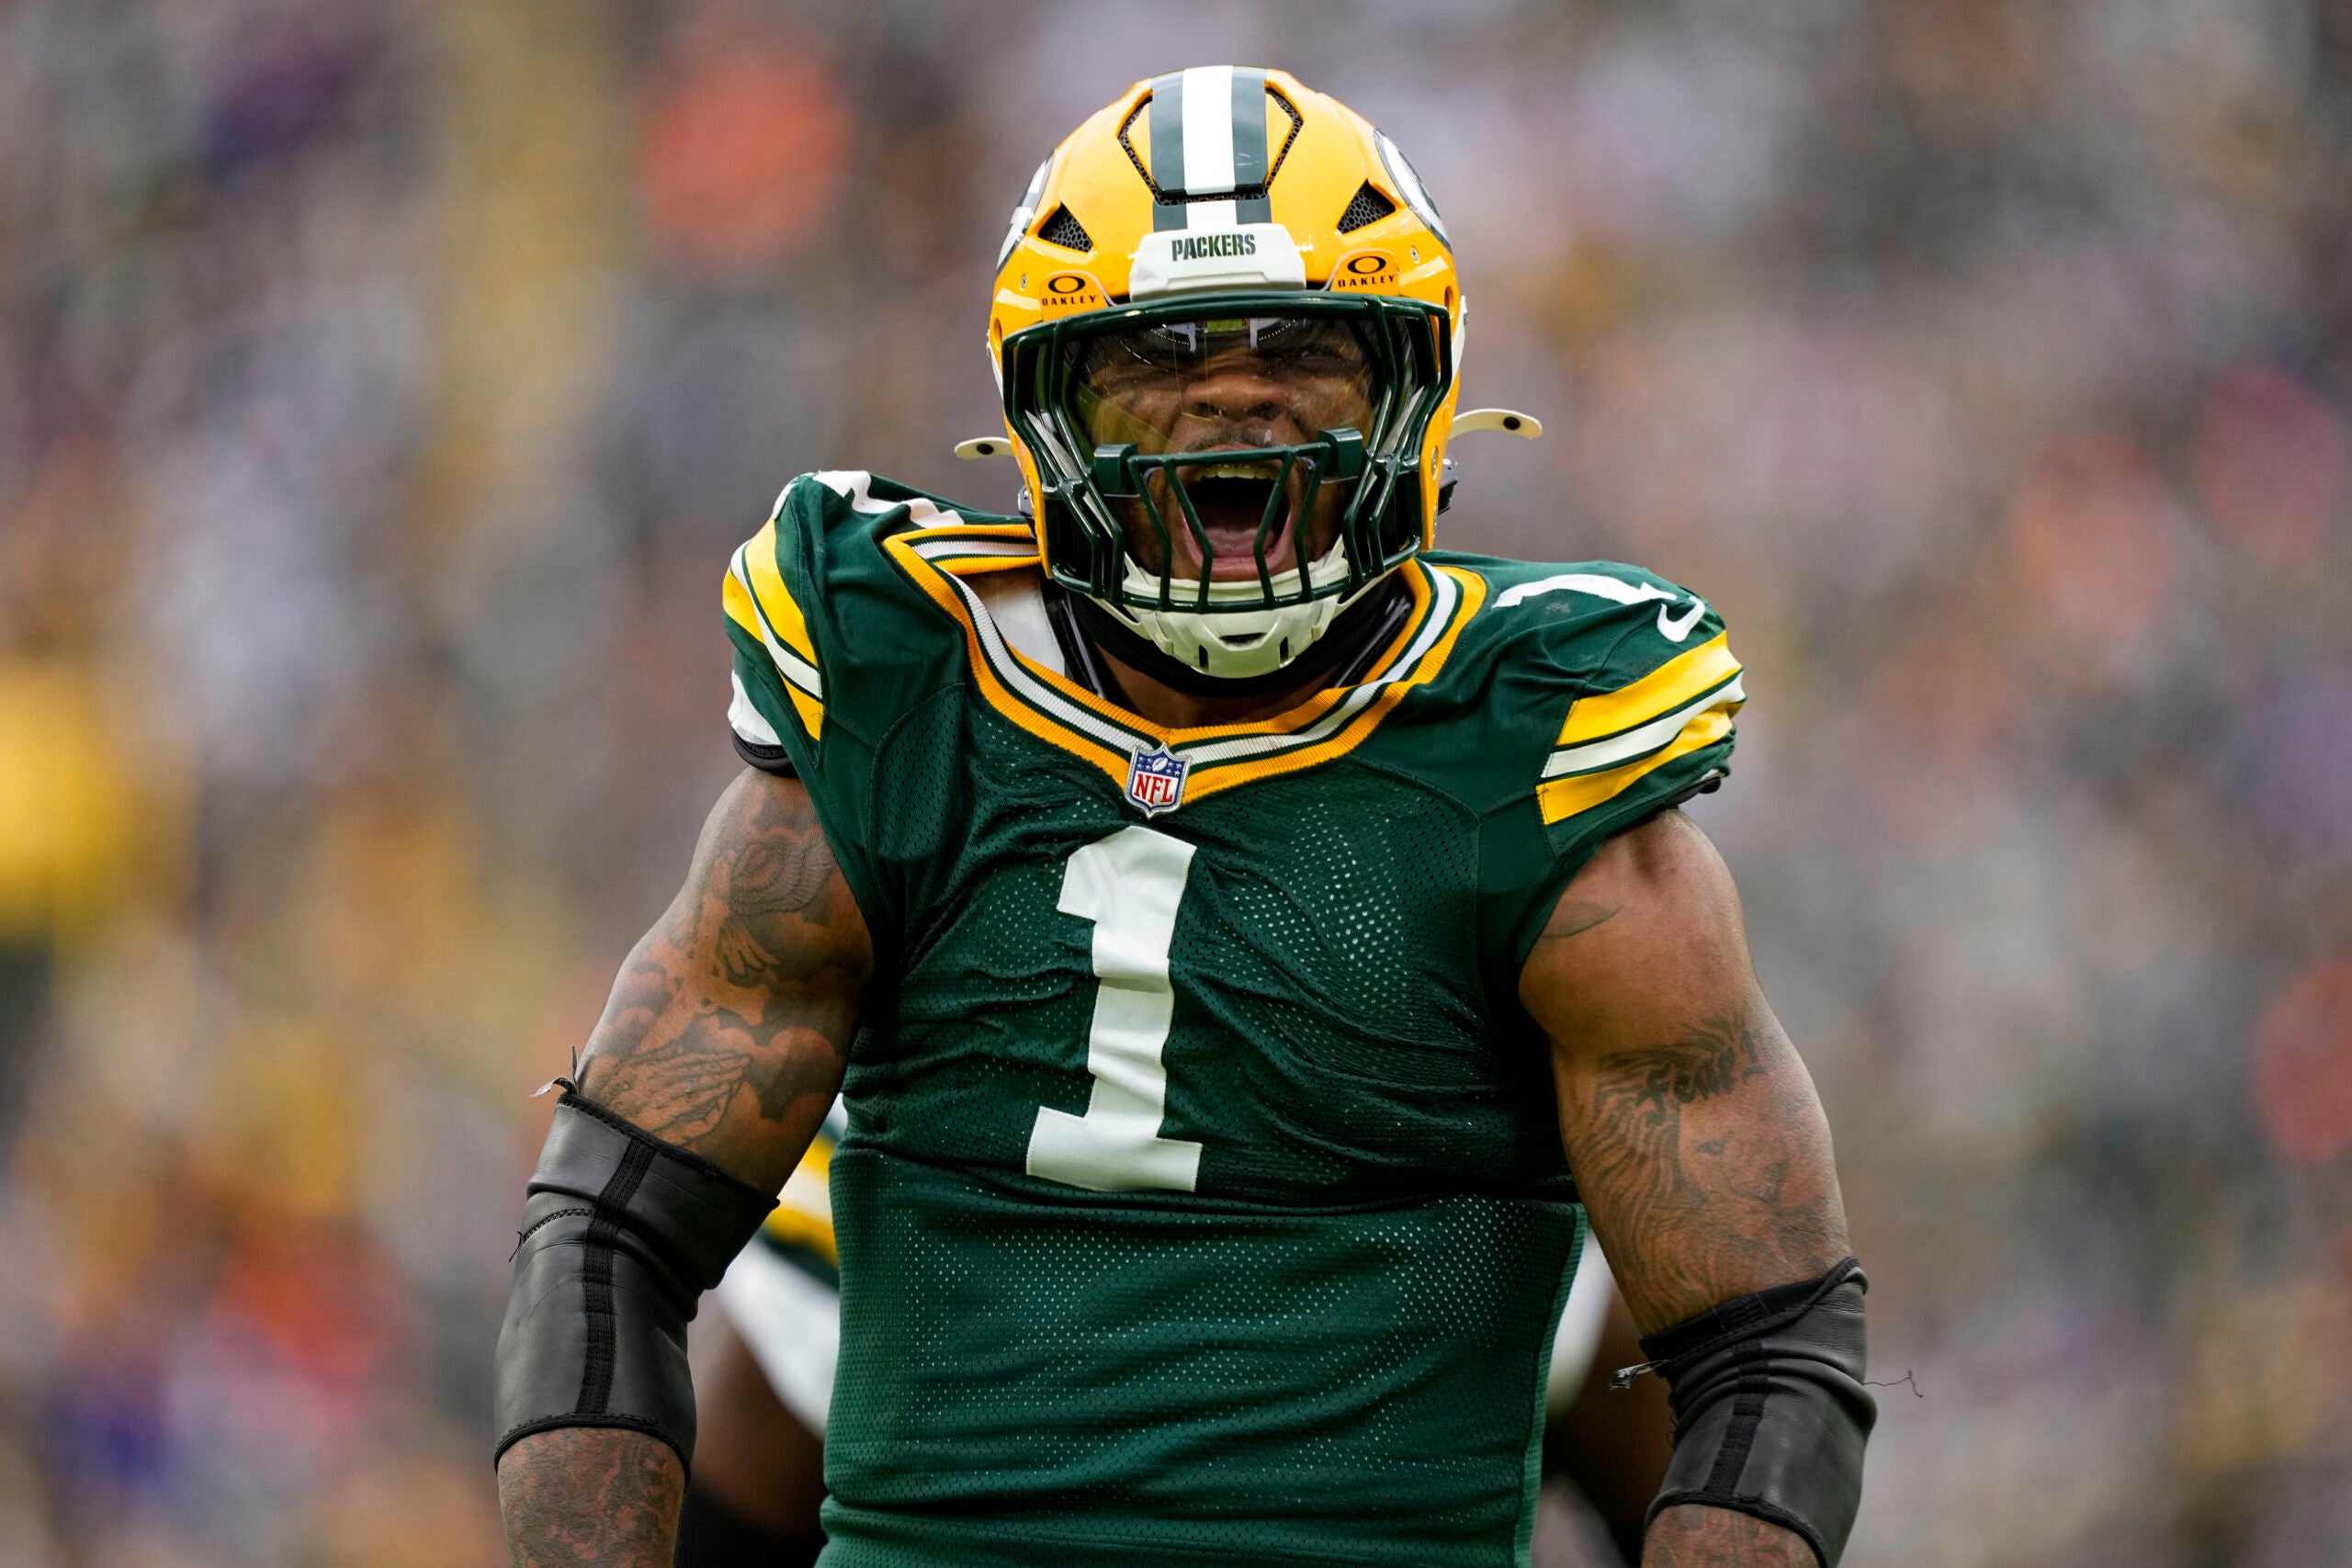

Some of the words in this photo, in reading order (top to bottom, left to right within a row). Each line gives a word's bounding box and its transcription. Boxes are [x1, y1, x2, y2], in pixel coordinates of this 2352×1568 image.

[1171, 234, 1256, 261] PACKERS
[1338, 275, 1394, 288] OAKLEY
[1042, 295, 1096, 306] OAKLEY
[1134, 773, 1173, 805] NFL
[1026, 825, 1203, 1192] 1
